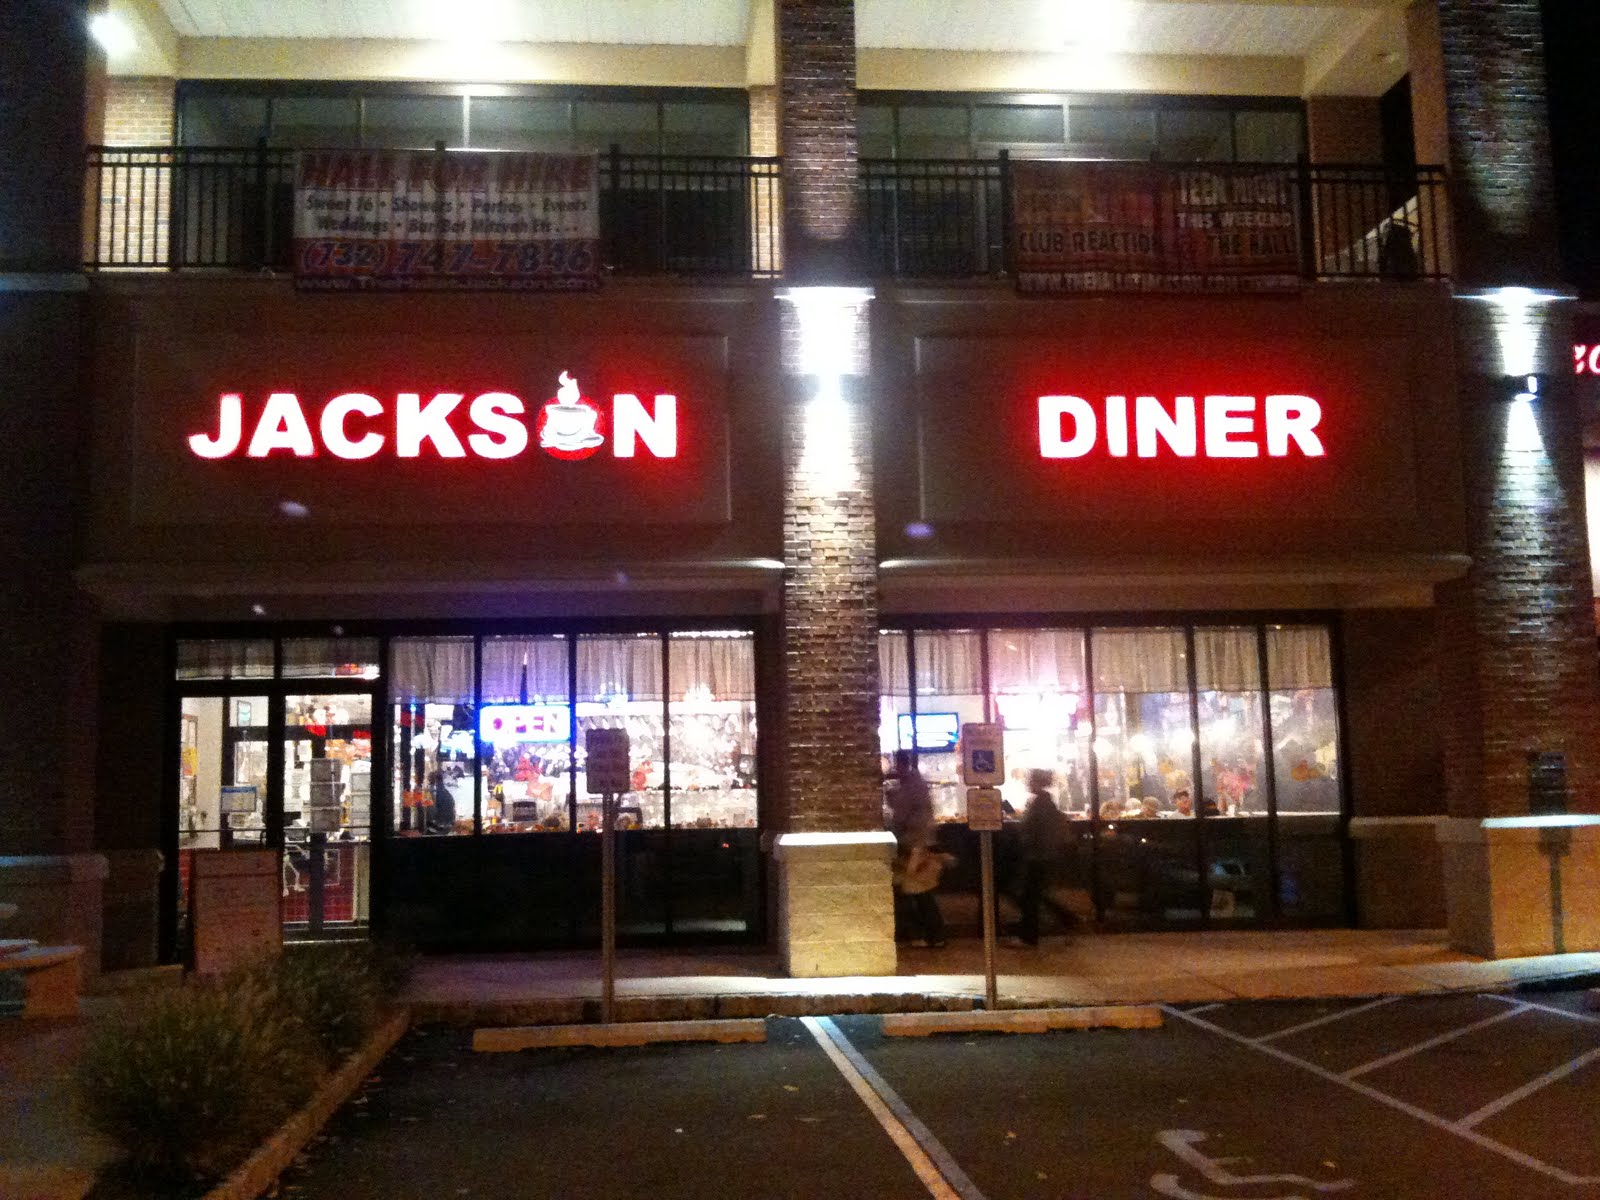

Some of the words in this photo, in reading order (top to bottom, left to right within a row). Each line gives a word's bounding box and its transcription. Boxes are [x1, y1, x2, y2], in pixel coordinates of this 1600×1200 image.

[1177, 212, 1213, 228] THIS
[1220, 211, 1292, 228] WEEKEND
[1018, 231, 1064, 254] CLUB
[1207, 233, 1242, 255] THE
[1249, 233, 1295, 255] HALL
[301, 240, 390, 275] (732)
[1038, 394, 1326, 458] DINER
[488, 710, 560, 737] OPEN
